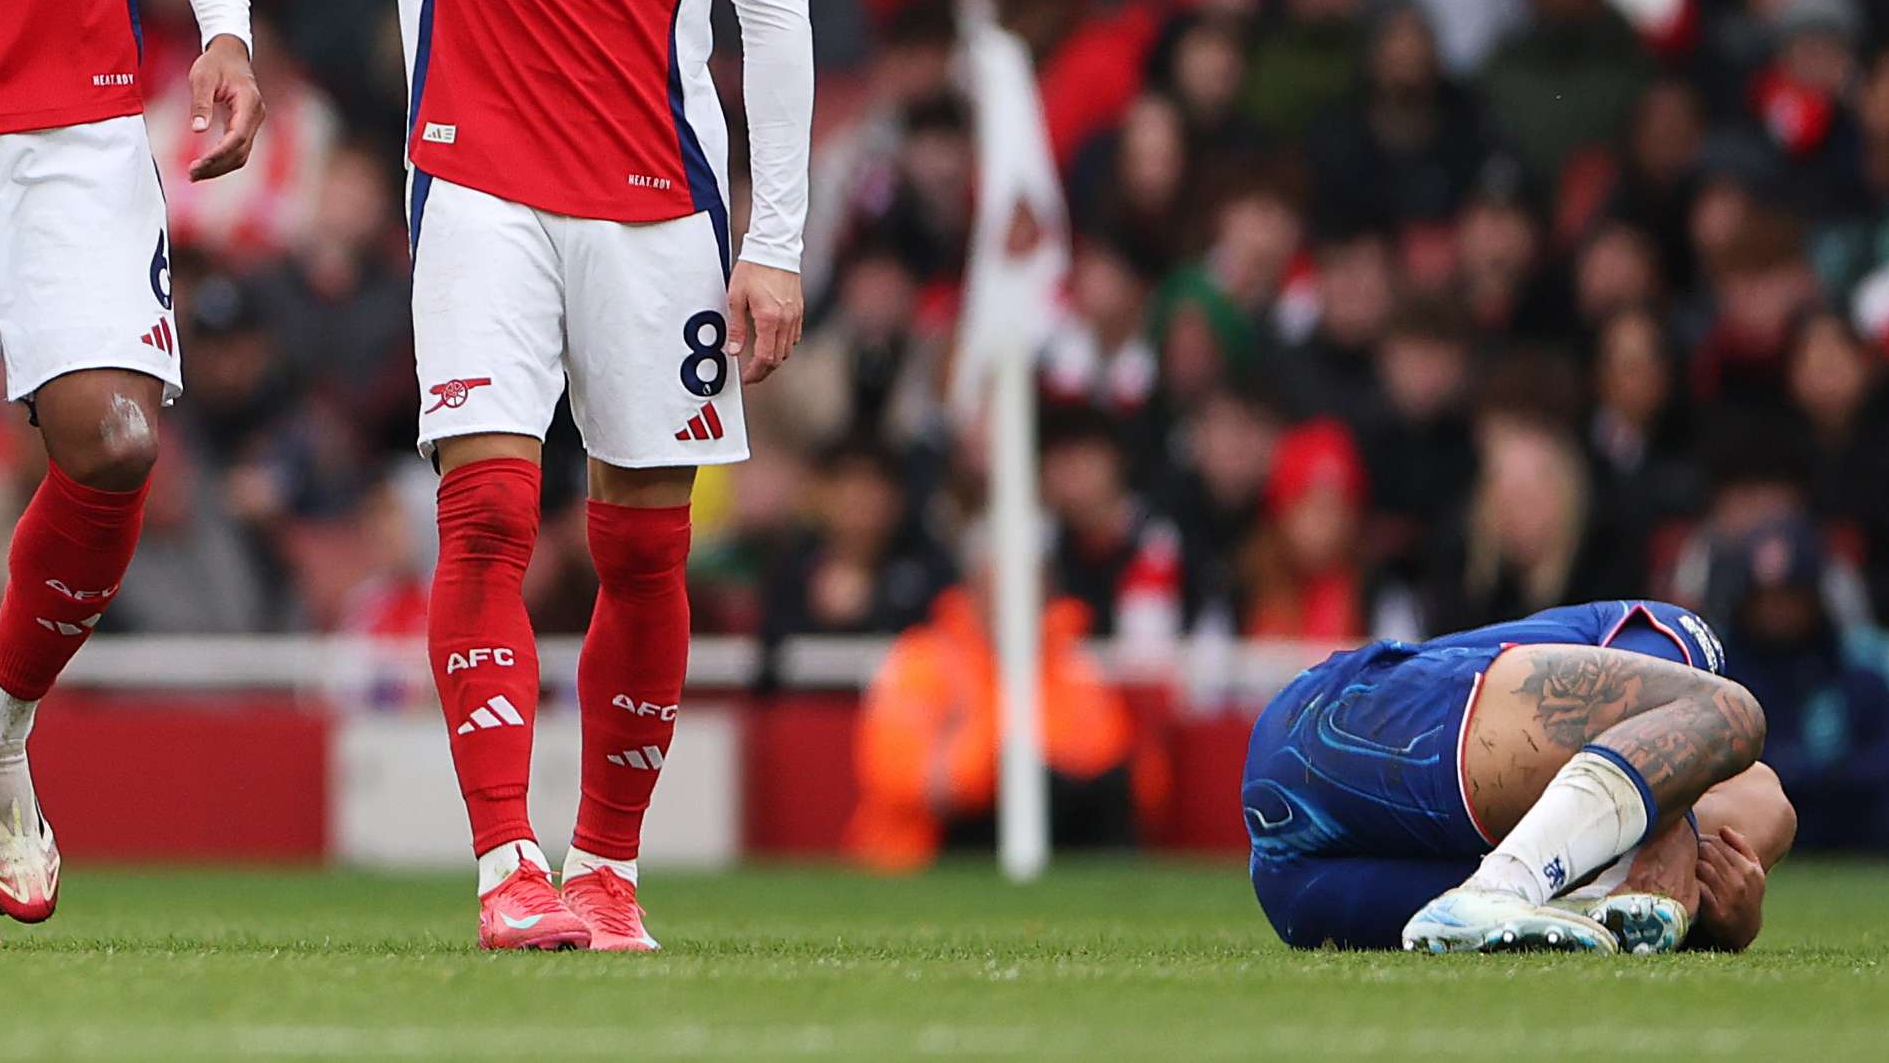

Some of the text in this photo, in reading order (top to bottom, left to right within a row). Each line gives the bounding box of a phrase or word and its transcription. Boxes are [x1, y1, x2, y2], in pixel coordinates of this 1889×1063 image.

[93, 73, 134, 86] HEAT.RDY
[628, 173, 671, 190] HEAT.RDY
[150, 227, 172, 310] 6
[680, 310, 728, 397] 8
[447, 647, 515, 675] AFC
[612, 693, 678, 722] AFC
